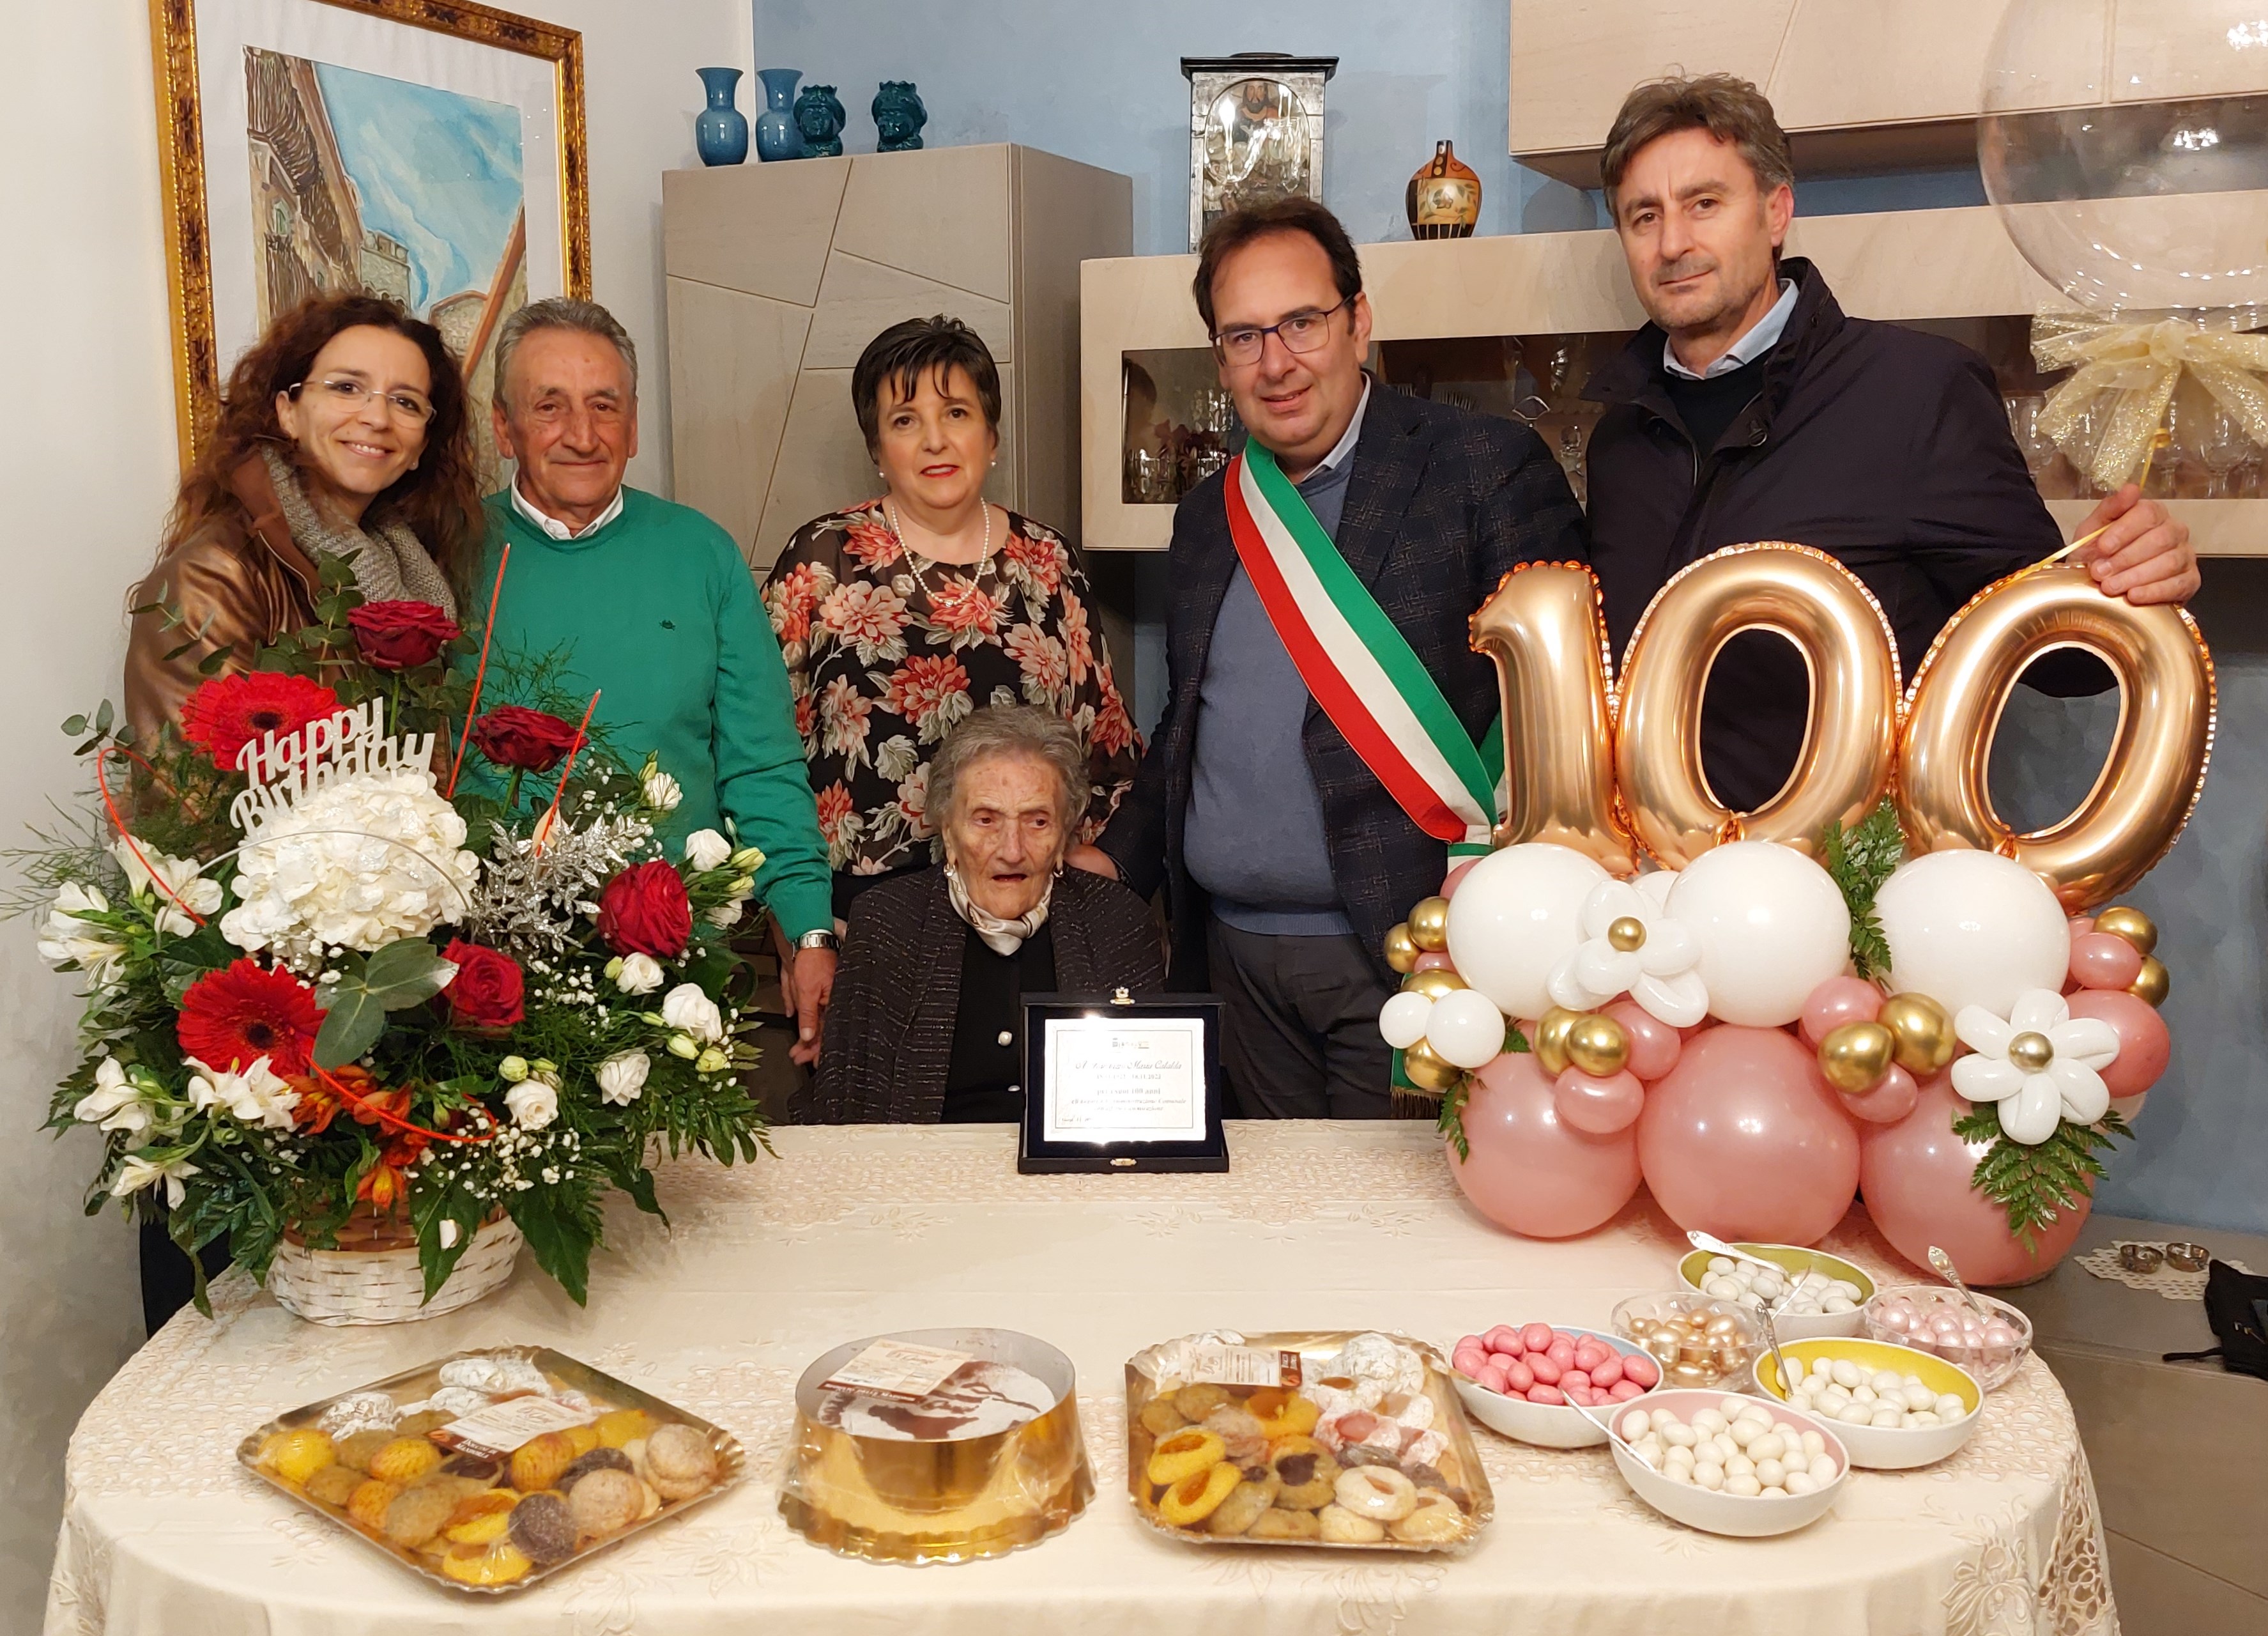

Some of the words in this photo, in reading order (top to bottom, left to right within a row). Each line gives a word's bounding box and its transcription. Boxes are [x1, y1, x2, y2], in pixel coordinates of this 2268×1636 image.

[236, 696, 383, 791] Happy
[1468, 543, 2218, 916] 100
[230, 733, 436, 840] Birthday
